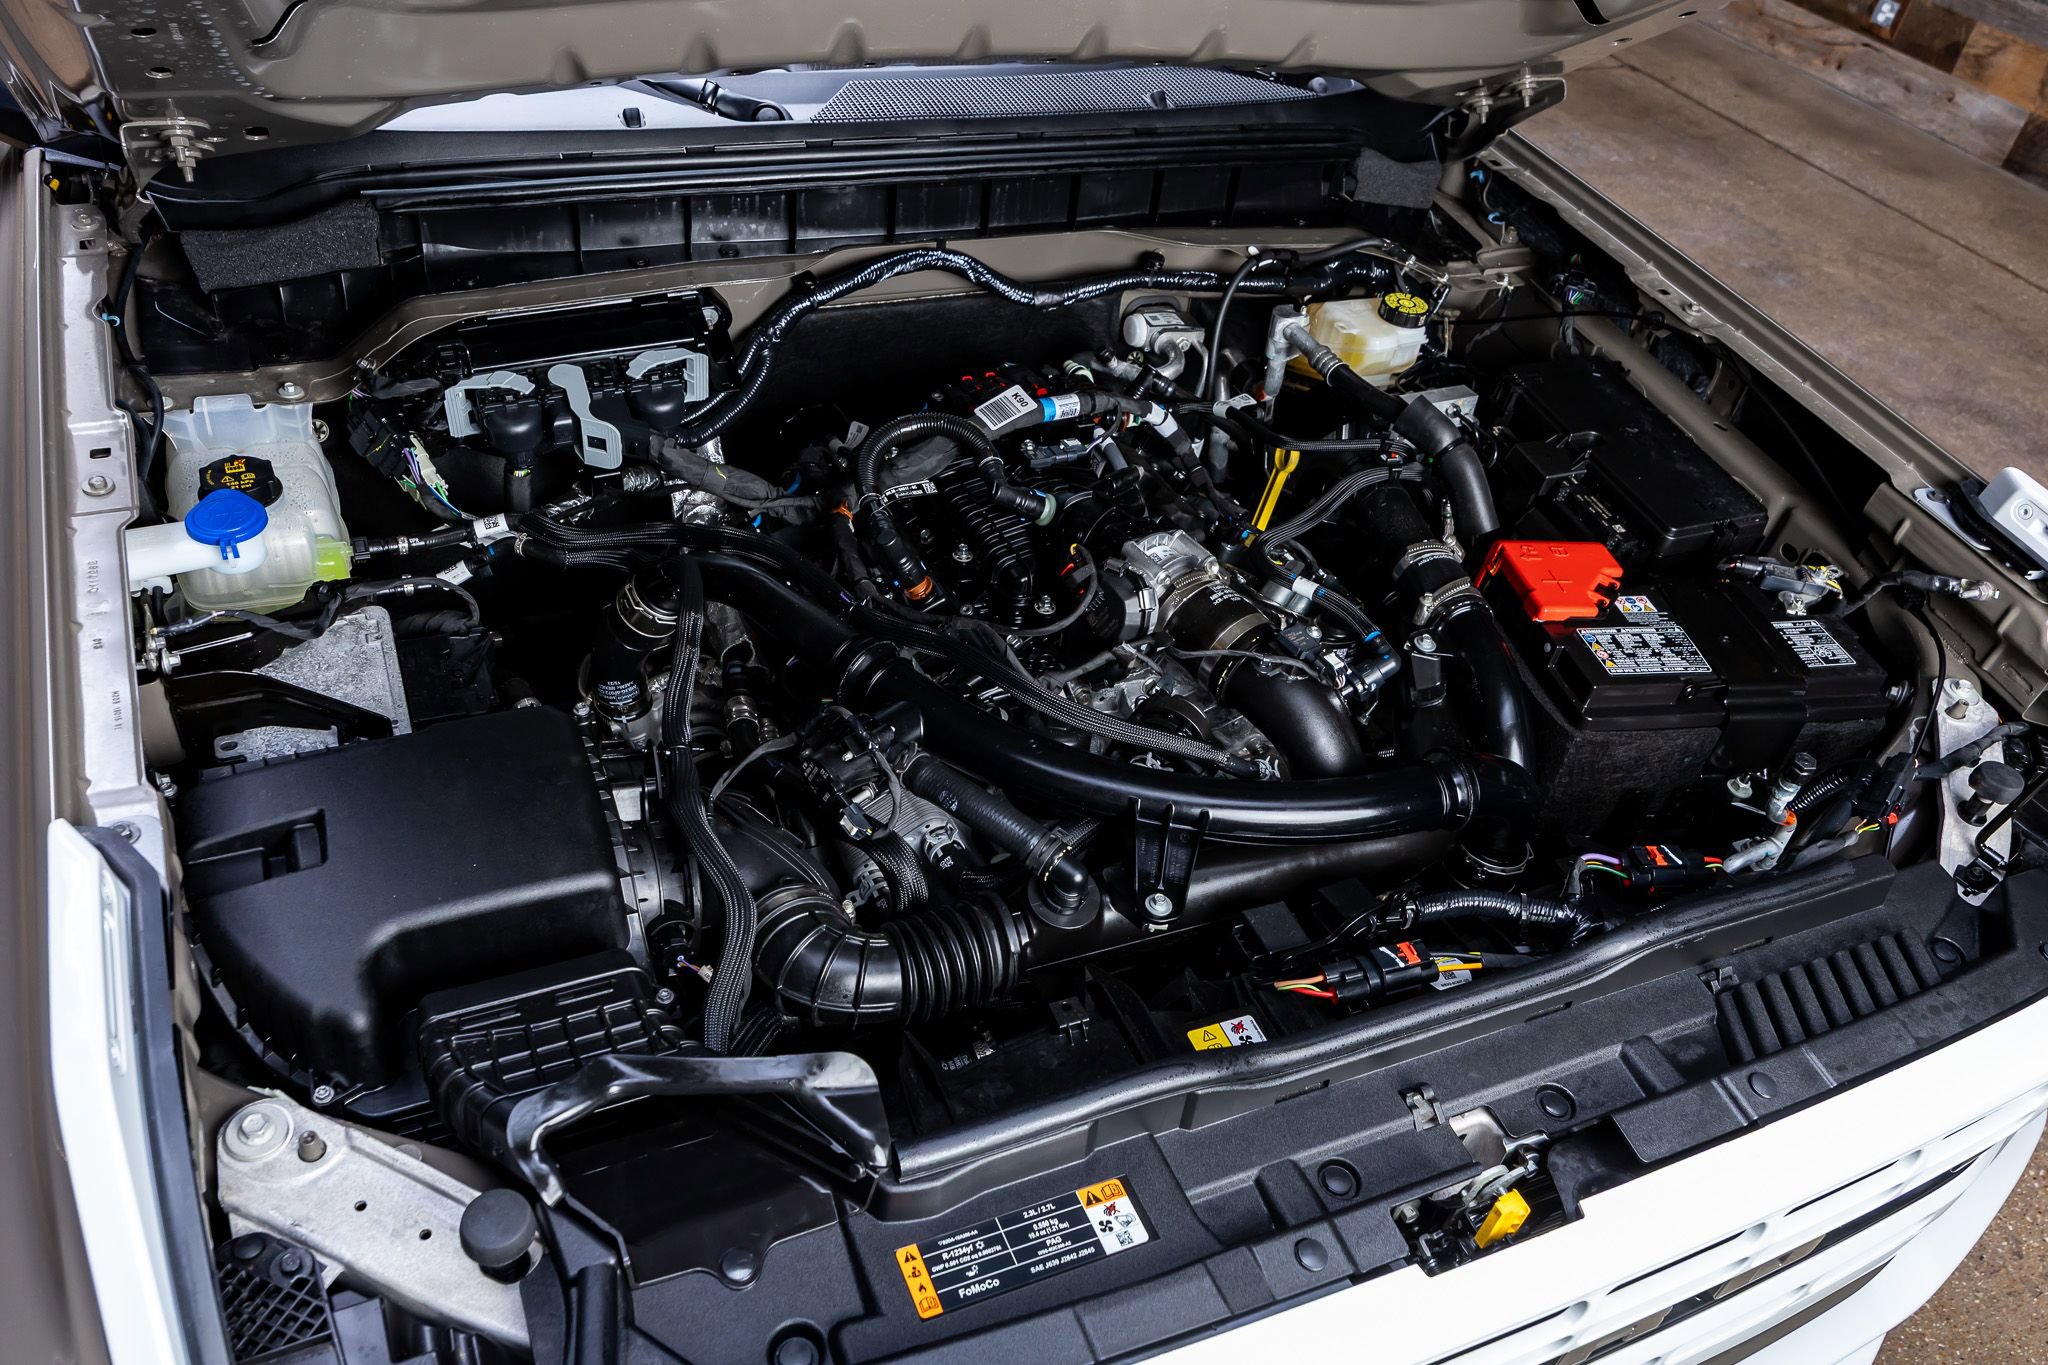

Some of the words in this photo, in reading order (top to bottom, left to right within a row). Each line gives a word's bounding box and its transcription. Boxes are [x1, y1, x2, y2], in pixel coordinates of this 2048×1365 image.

[1011, 392, 1029, 408] K90
[1022, 1208, 1038, 1219] 2.3L
[1040, 1203, 1056, 1213] 2.7L
[1049, 1218, 1059, 1227] kg
[1045, 1236, 1062, 1247] PAG
[941, 1244, 974, 1261] R-1234yf
[959, 1254, 971, 1264] CO2
[1030, 1263, 1045, 1274] SAE
[958, 1278, 1000, 1299] FoMoCo
